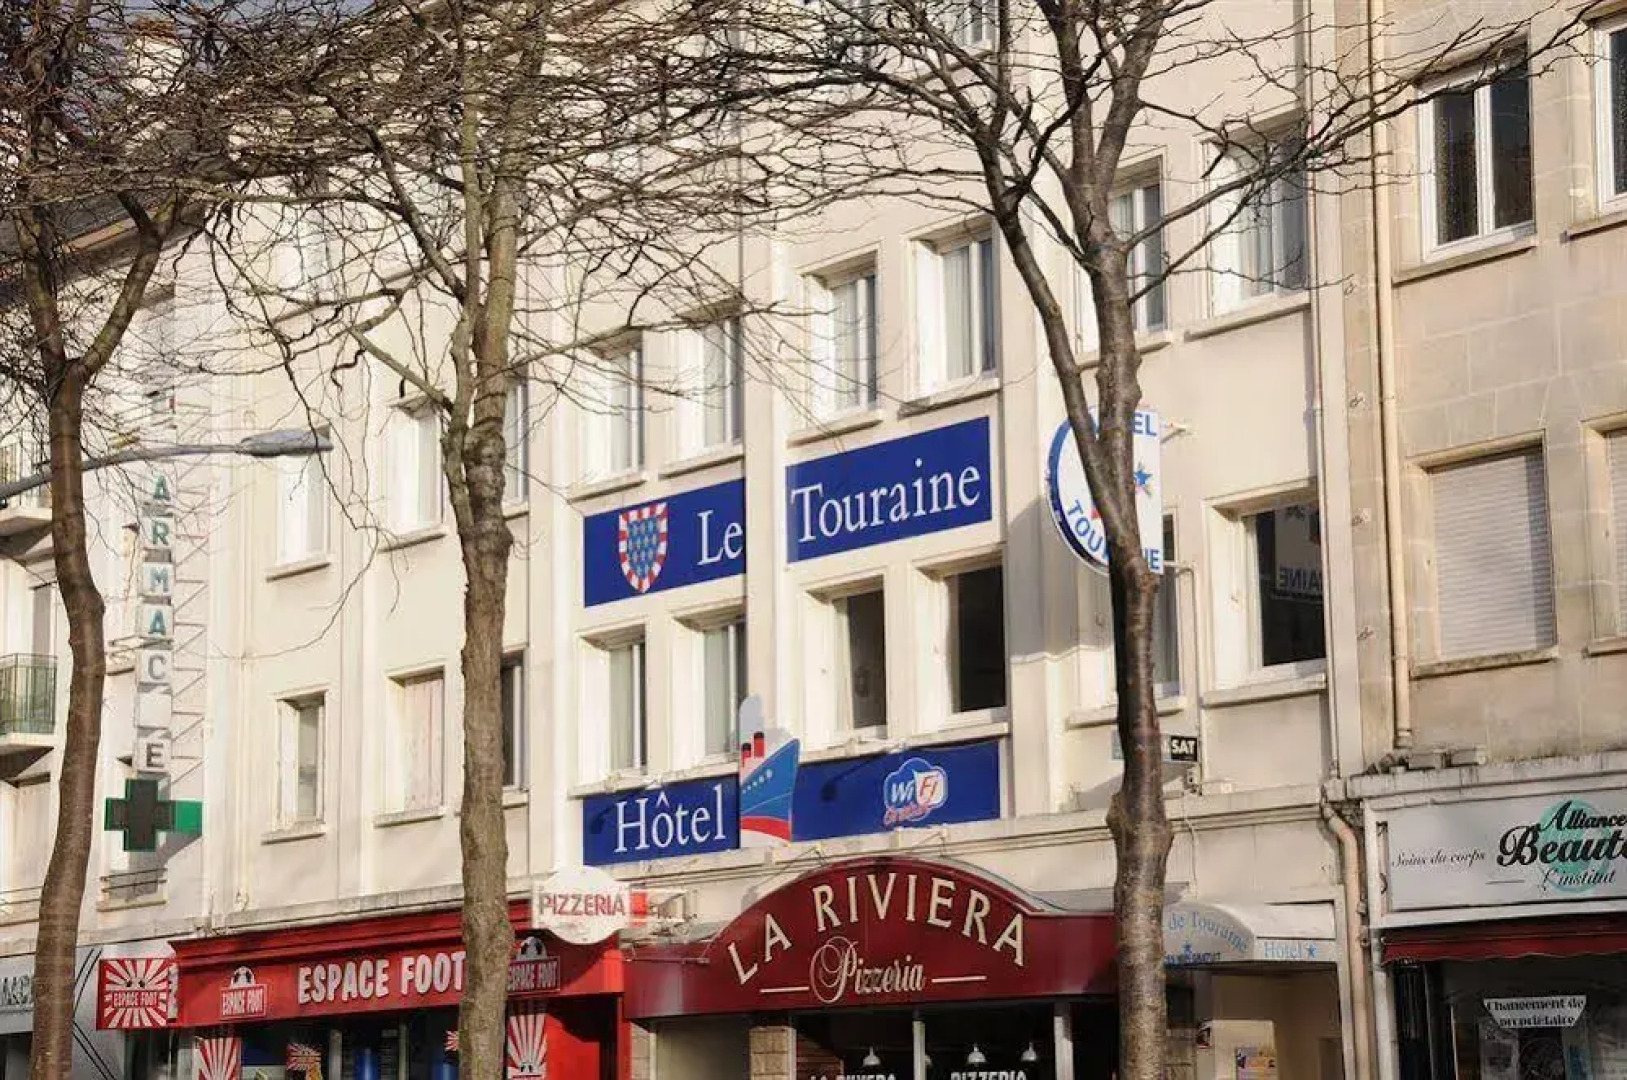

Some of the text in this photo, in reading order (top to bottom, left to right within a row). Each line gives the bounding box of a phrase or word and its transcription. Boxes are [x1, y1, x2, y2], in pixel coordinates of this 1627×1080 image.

[697, 457, 982, 566] Le Touraine
[1171, 738, 1196, 755] SAT
[614, 783, 727, 853] Hôtel
[540, 893, 626, 917] PIZZERIA
[728, 872, 1026, 985] LA RIVIERA
[298, 950, 467, 1004] ESPACE FOOT
[810, 936, 924, 1003] Pizzeria
